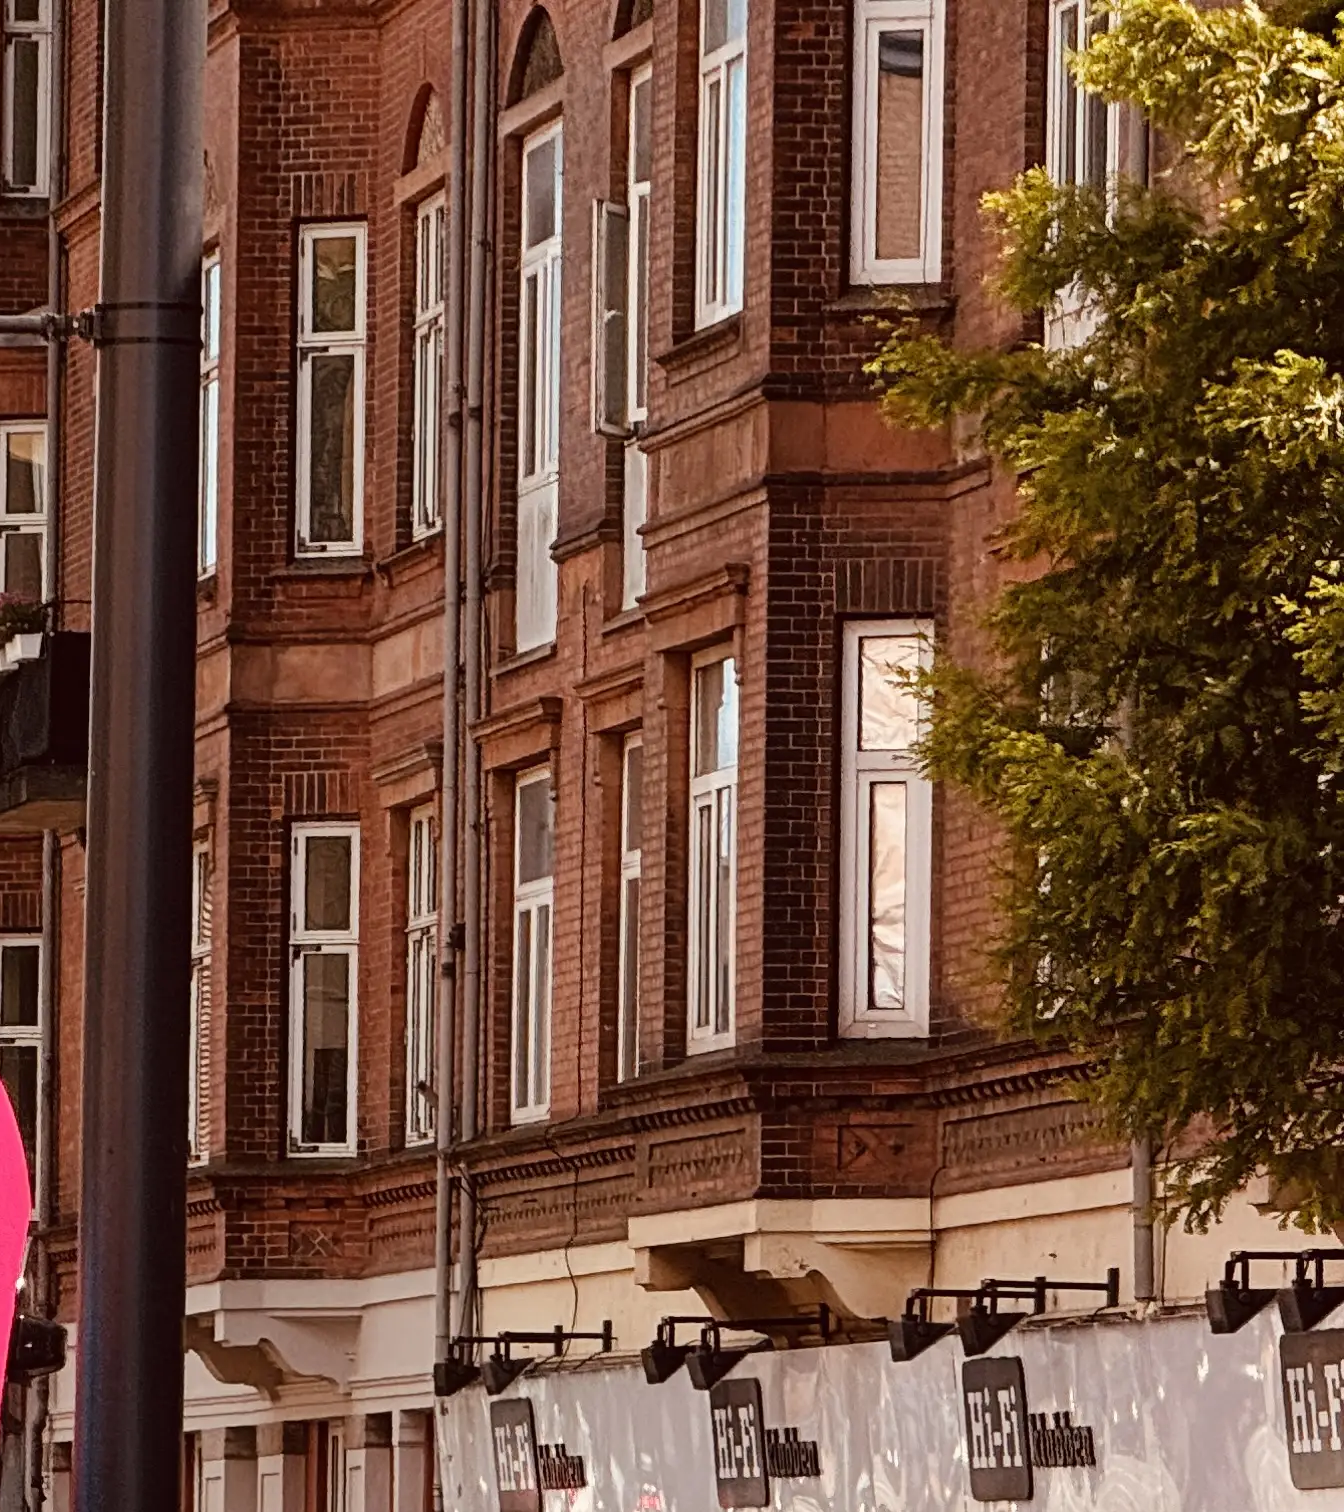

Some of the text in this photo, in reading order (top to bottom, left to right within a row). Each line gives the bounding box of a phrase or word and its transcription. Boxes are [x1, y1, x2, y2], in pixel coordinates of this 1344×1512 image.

[713, 1403, 760, 1480] Hi-Fi
[967, 1386, 1024, 1469] Hi-Fi
[1285, 1360, 1344, 1453] Hi-F
[494, 1422, 536, 1491] Hi-Fi
